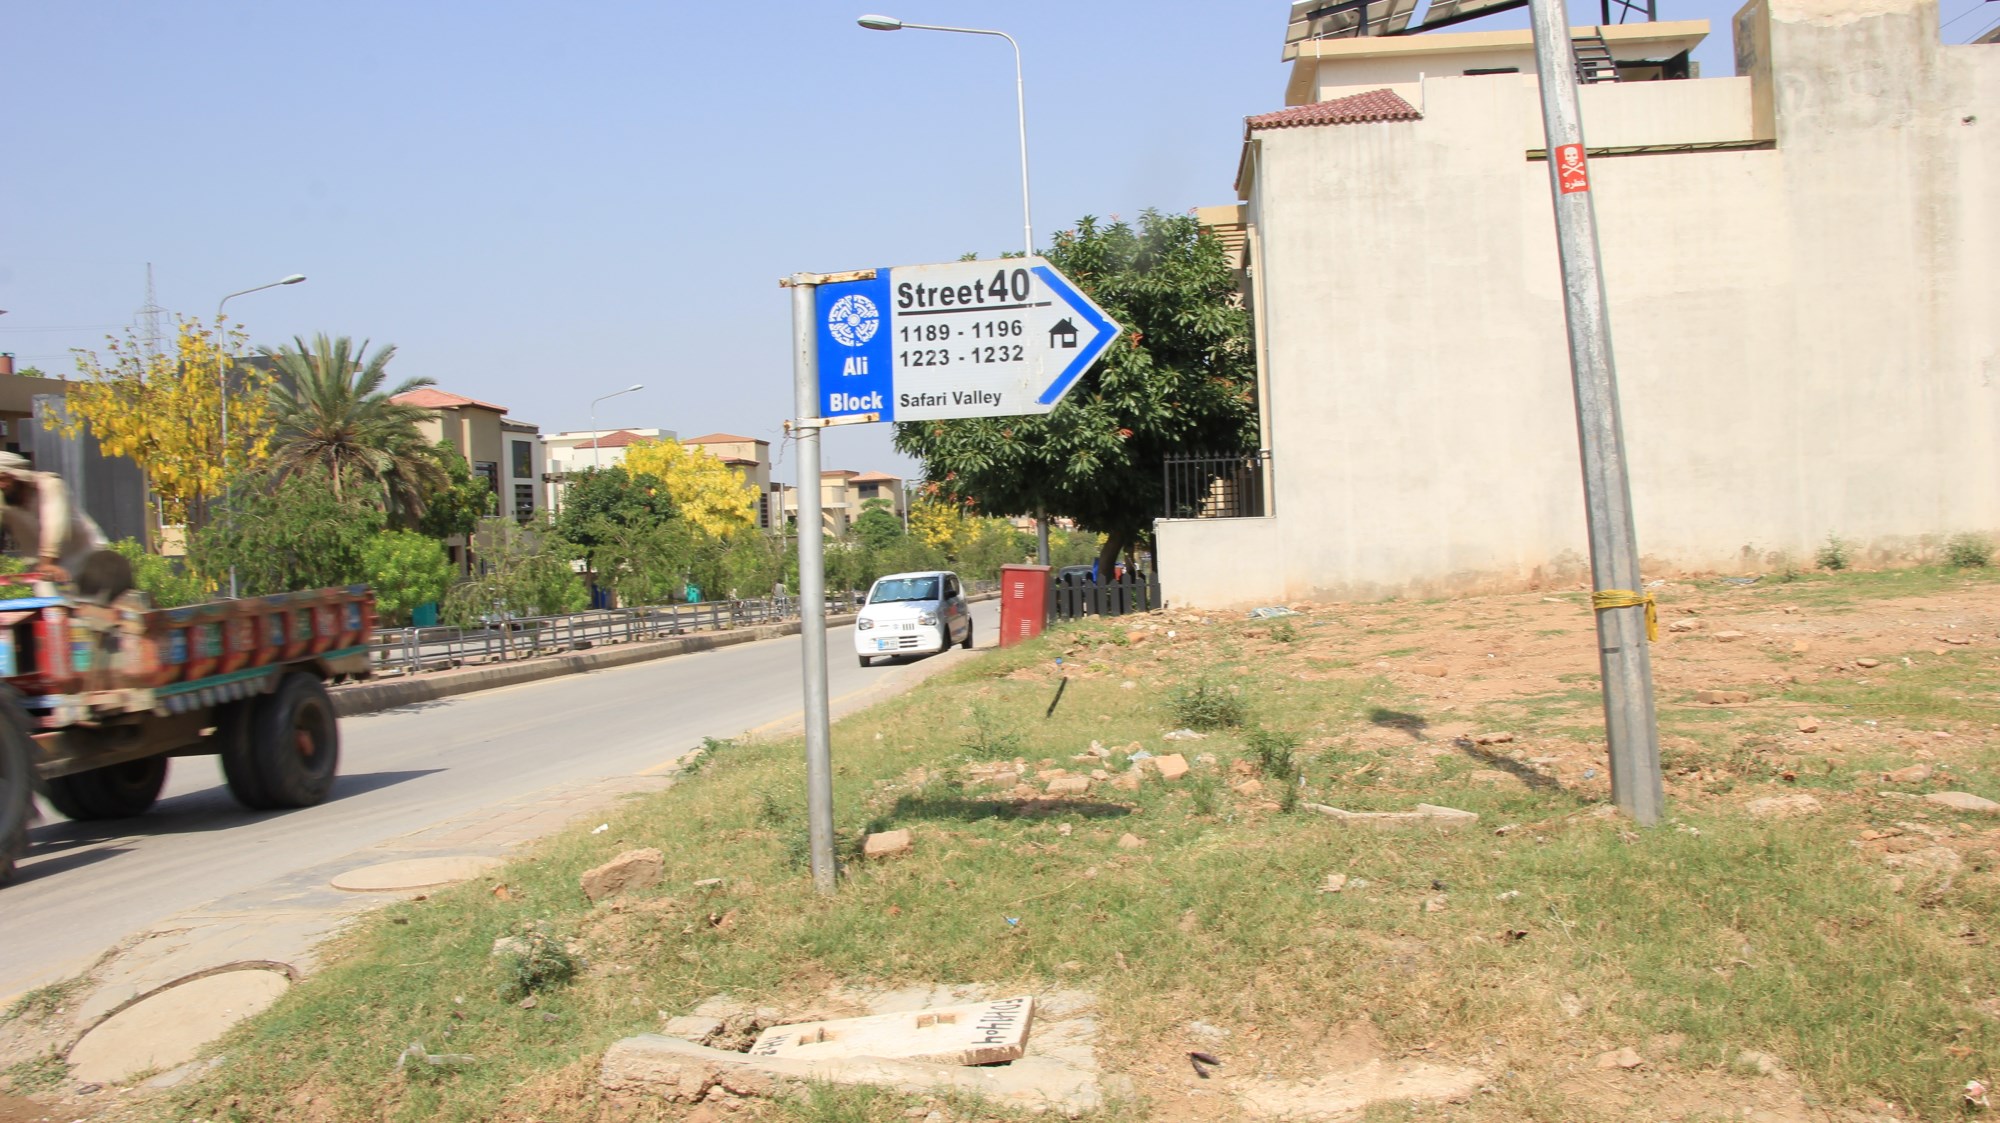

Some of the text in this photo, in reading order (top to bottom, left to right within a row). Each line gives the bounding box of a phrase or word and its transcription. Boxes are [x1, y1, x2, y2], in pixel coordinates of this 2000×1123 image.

[897, 268, 1030, 309] Street 40
[900, 323, 950, 343] 1189
[972, 319, 1022, 339] 1196
[900, 349, 950, 367] 1223
[972, 345, 1024, 363] 1232
[842, 357, 869, 377] Ali
[829, 391, 883, 412] Block
[900, 390, 1002, 408] Safari Valley
